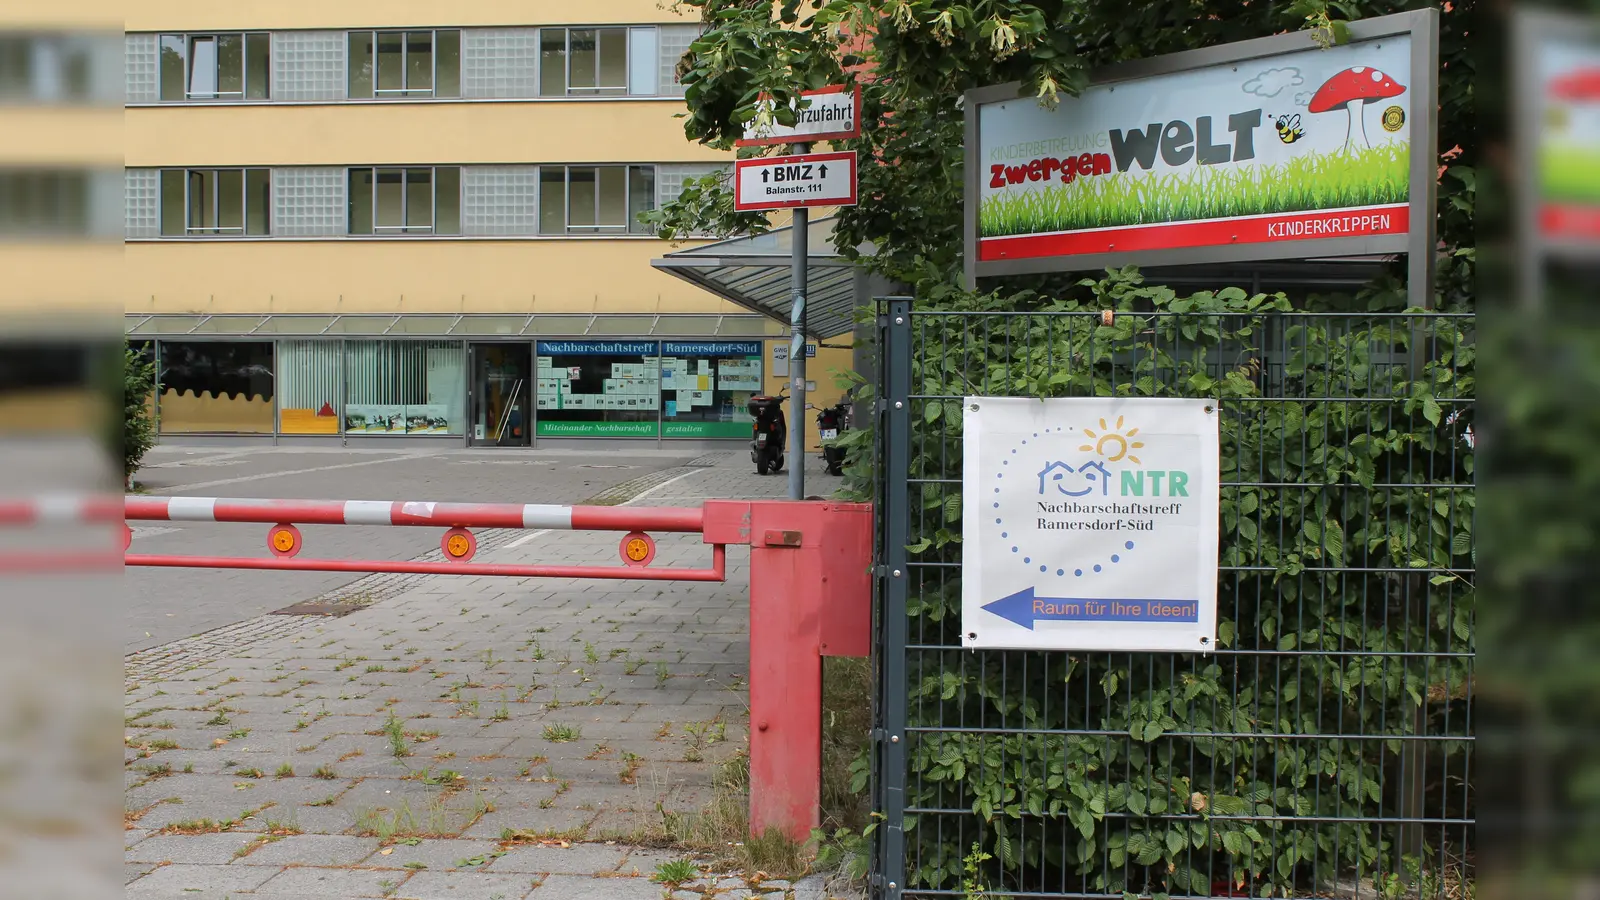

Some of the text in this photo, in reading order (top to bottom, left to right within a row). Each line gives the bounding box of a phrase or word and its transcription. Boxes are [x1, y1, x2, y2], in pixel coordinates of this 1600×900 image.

[990, 132, 1108, 161] KINDERBETREUUNG
[774, 165, 813, 182] BMZ
[989, 152, 1112, 188] zwergen
[766, 184, 822, 195] Balanstr. 111
[1268, 214, 1391, 238] KINDERKRIPPEN
[543, 342, 757, 353] Nachbarschaftstreff Ramersdorf-Süd
[544, 424, 702, 433] Miteinander Nachbarschaft gestalten
[1120, 470, 1190, 497] NTR
[1036, 501, 1182, 515] Nachbarschaftstreff
[1036, 517, 1154, 531] Ramersdorf-Süd
[1032, 599, 1196, 617] Raum für Ihre Ideen!
